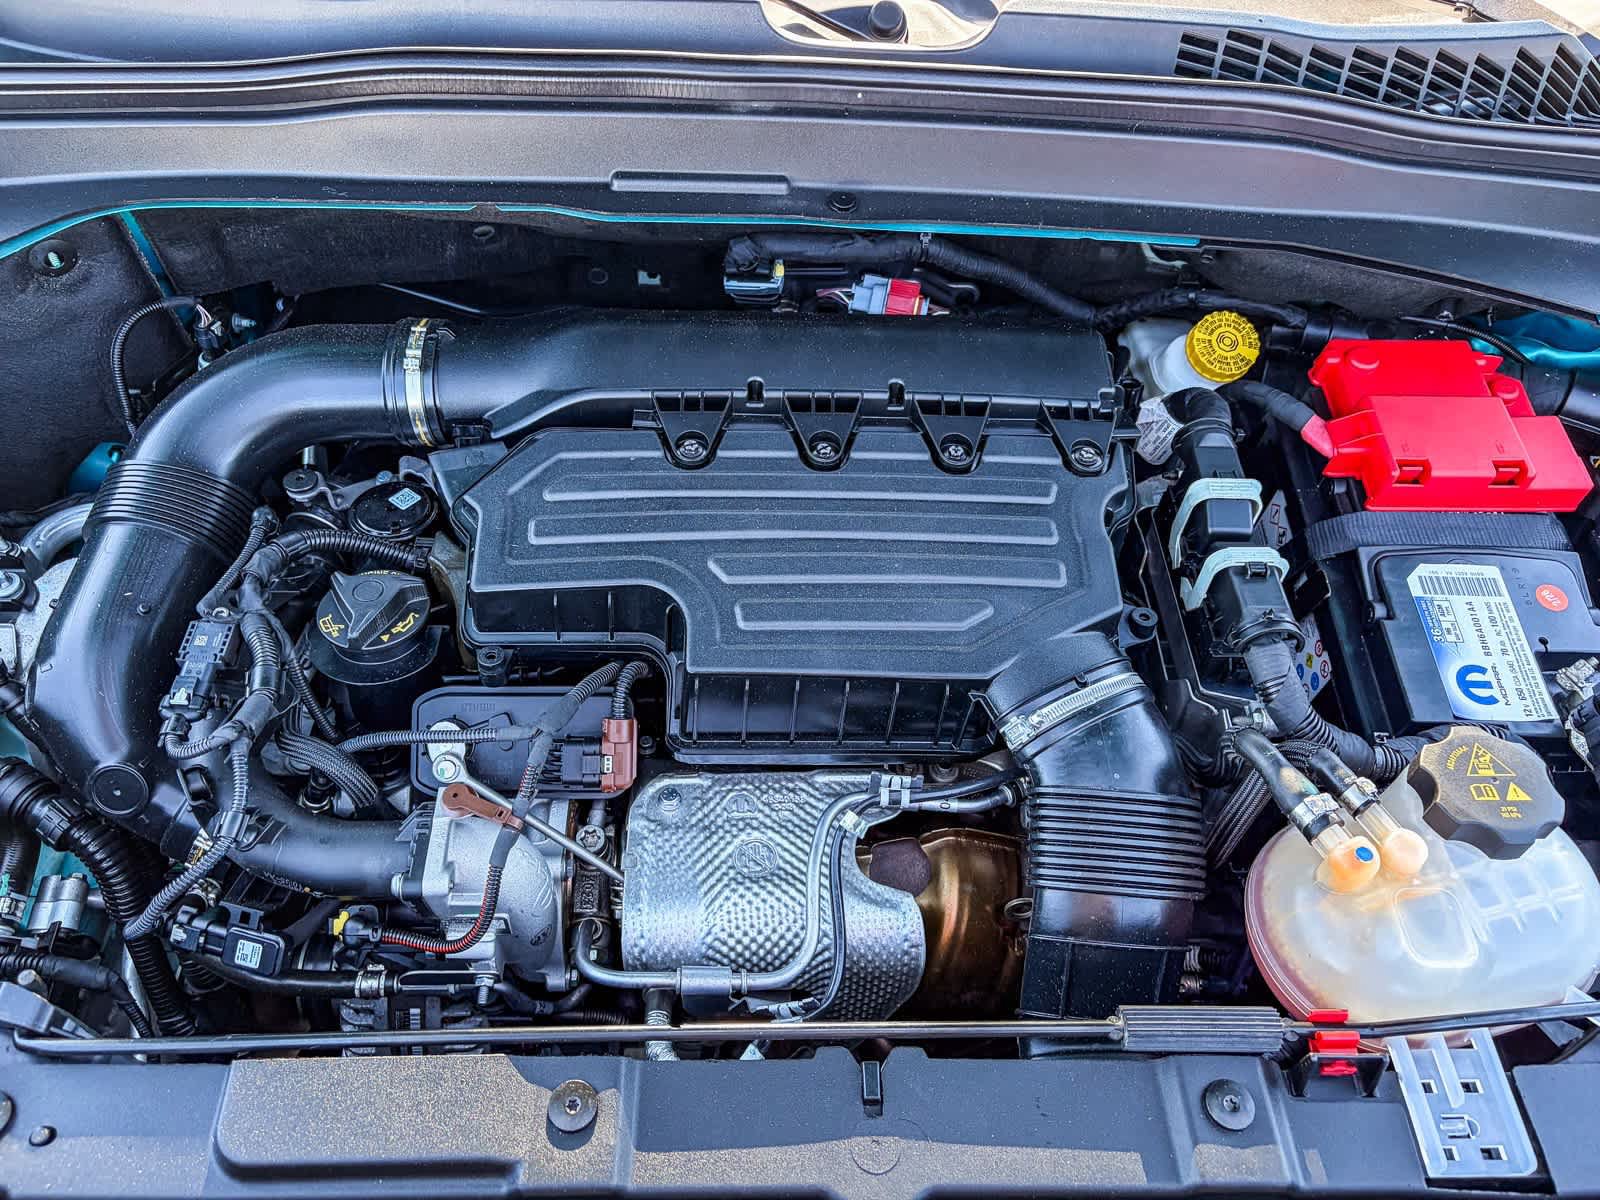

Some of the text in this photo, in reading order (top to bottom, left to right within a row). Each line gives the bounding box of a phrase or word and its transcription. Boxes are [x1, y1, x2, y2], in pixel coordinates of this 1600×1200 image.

[1486, 615, 1499, 627] 100
[1430, 628, 1444, 641] 36
[1490, 665, 1511, 705] MOPAR
[1514, 687, 1527, 700] 650
